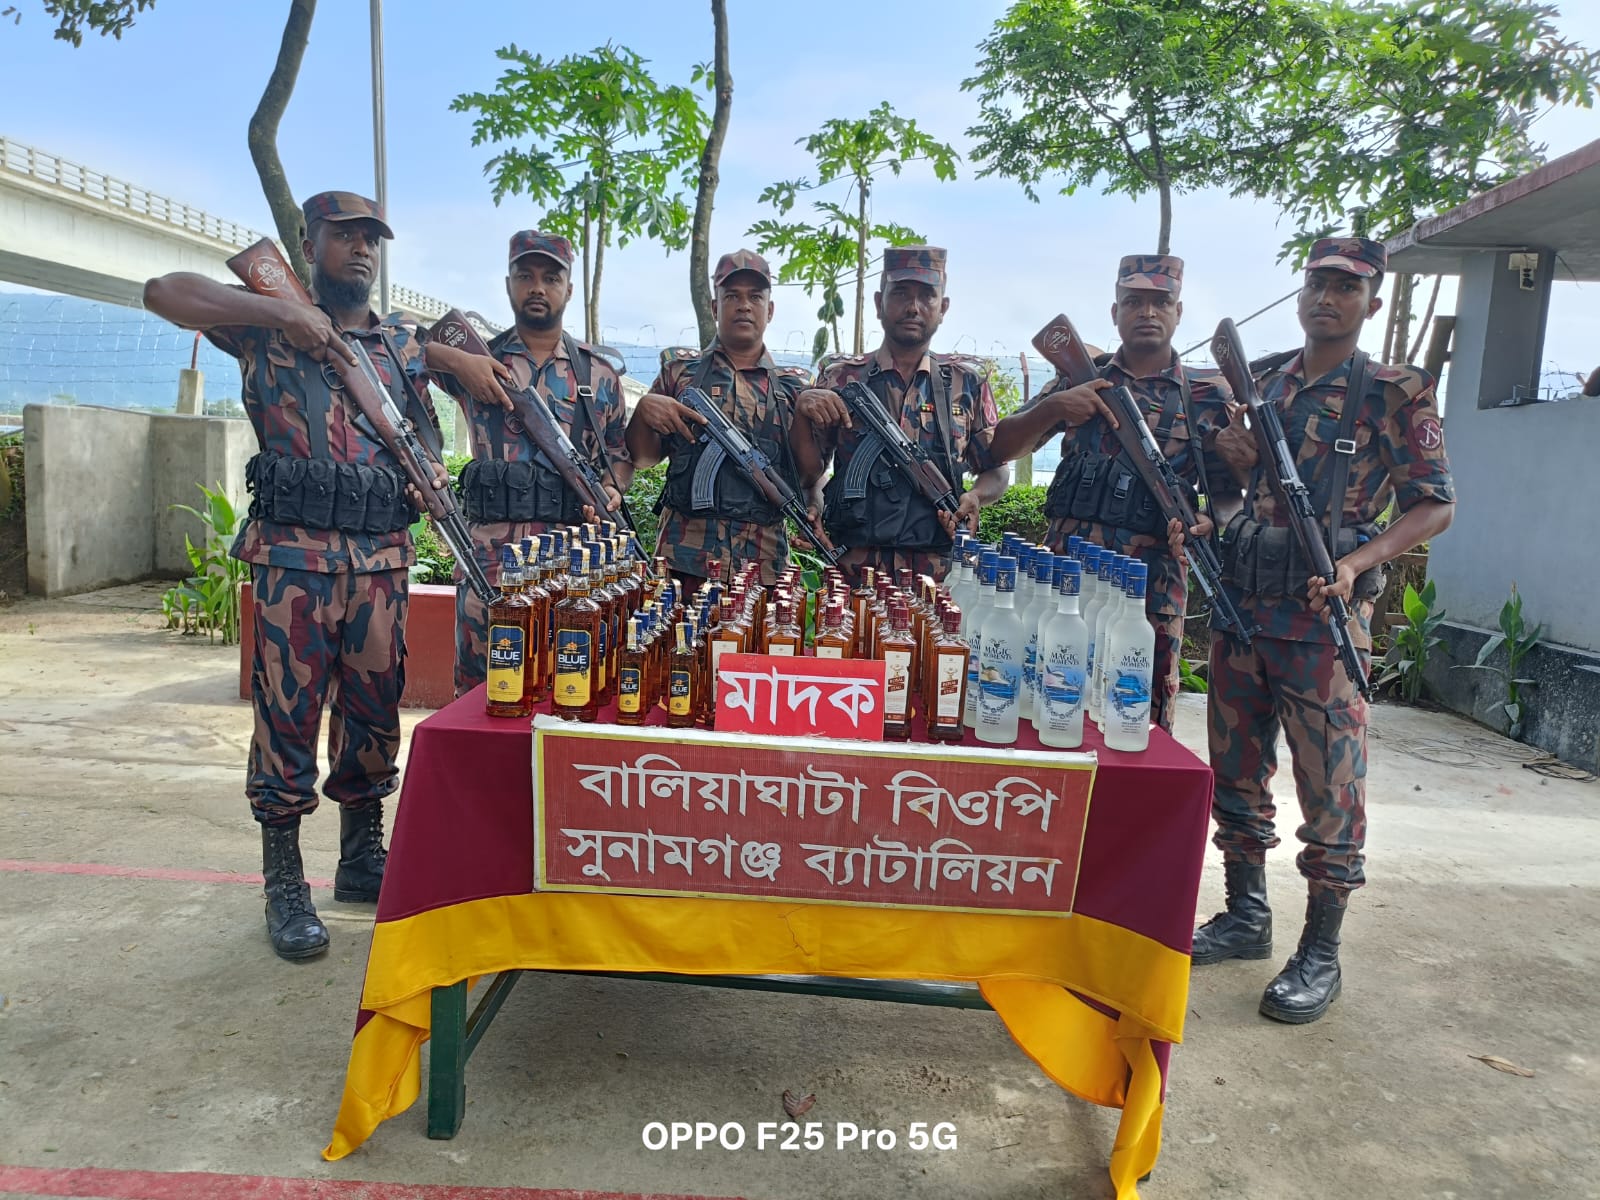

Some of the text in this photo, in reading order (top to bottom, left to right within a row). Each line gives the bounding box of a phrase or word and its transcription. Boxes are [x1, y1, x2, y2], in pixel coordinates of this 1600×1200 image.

[491, 649, 520, 660] BLUE
[985, 645, 1009, 655] MAGIC
[557, 654, 587, 665] BLUE
[1051, 652, 1078, 661] MAGIC
[1122, 655, 1149, 663] MAGIC
[718, 665, 880, 729] মাদক
[572, 753, 1060, 833] বালিয়াঘাটা বিওপি
[560, 828, 1063, 897] সুনামগঞ্জ ব্যাটালিয়ন
